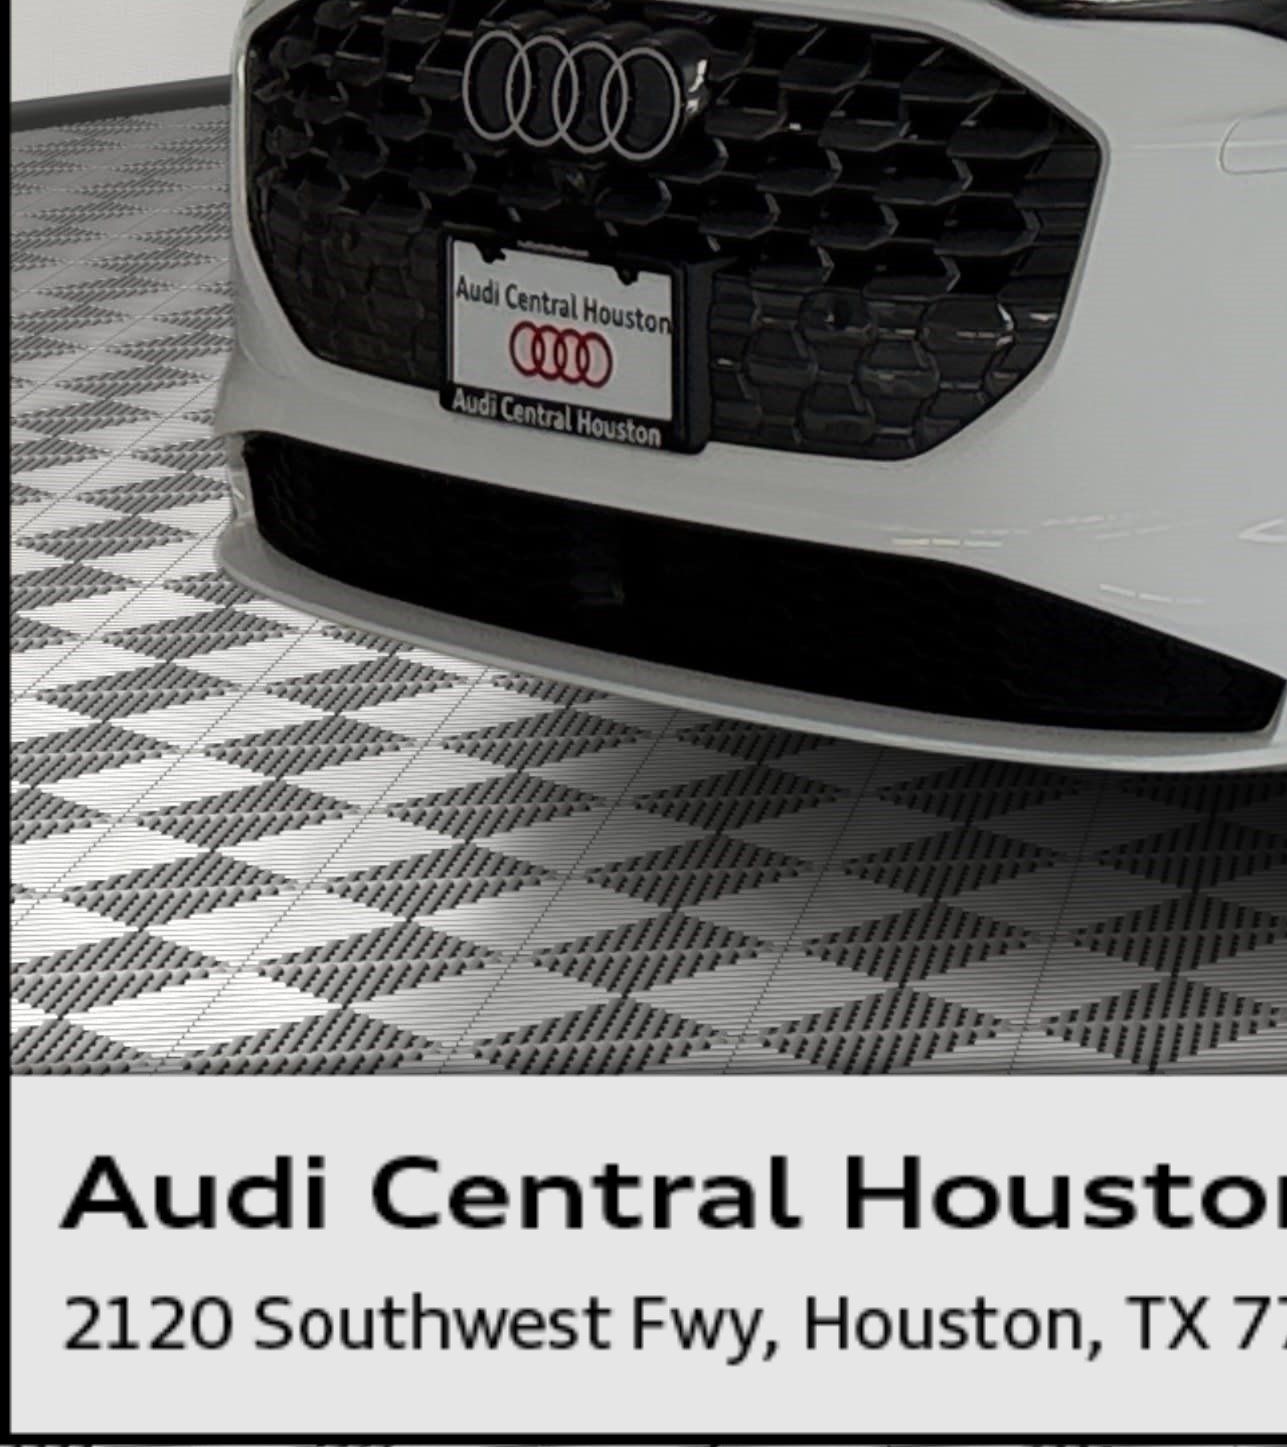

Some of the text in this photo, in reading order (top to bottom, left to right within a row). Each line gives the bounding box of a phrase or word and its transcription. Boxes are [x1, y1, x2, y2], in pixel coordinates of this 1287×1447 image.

[456, 274, 672, 335] Audi Central Houston
[451, 388, 662, 448] Audi Central Houston
